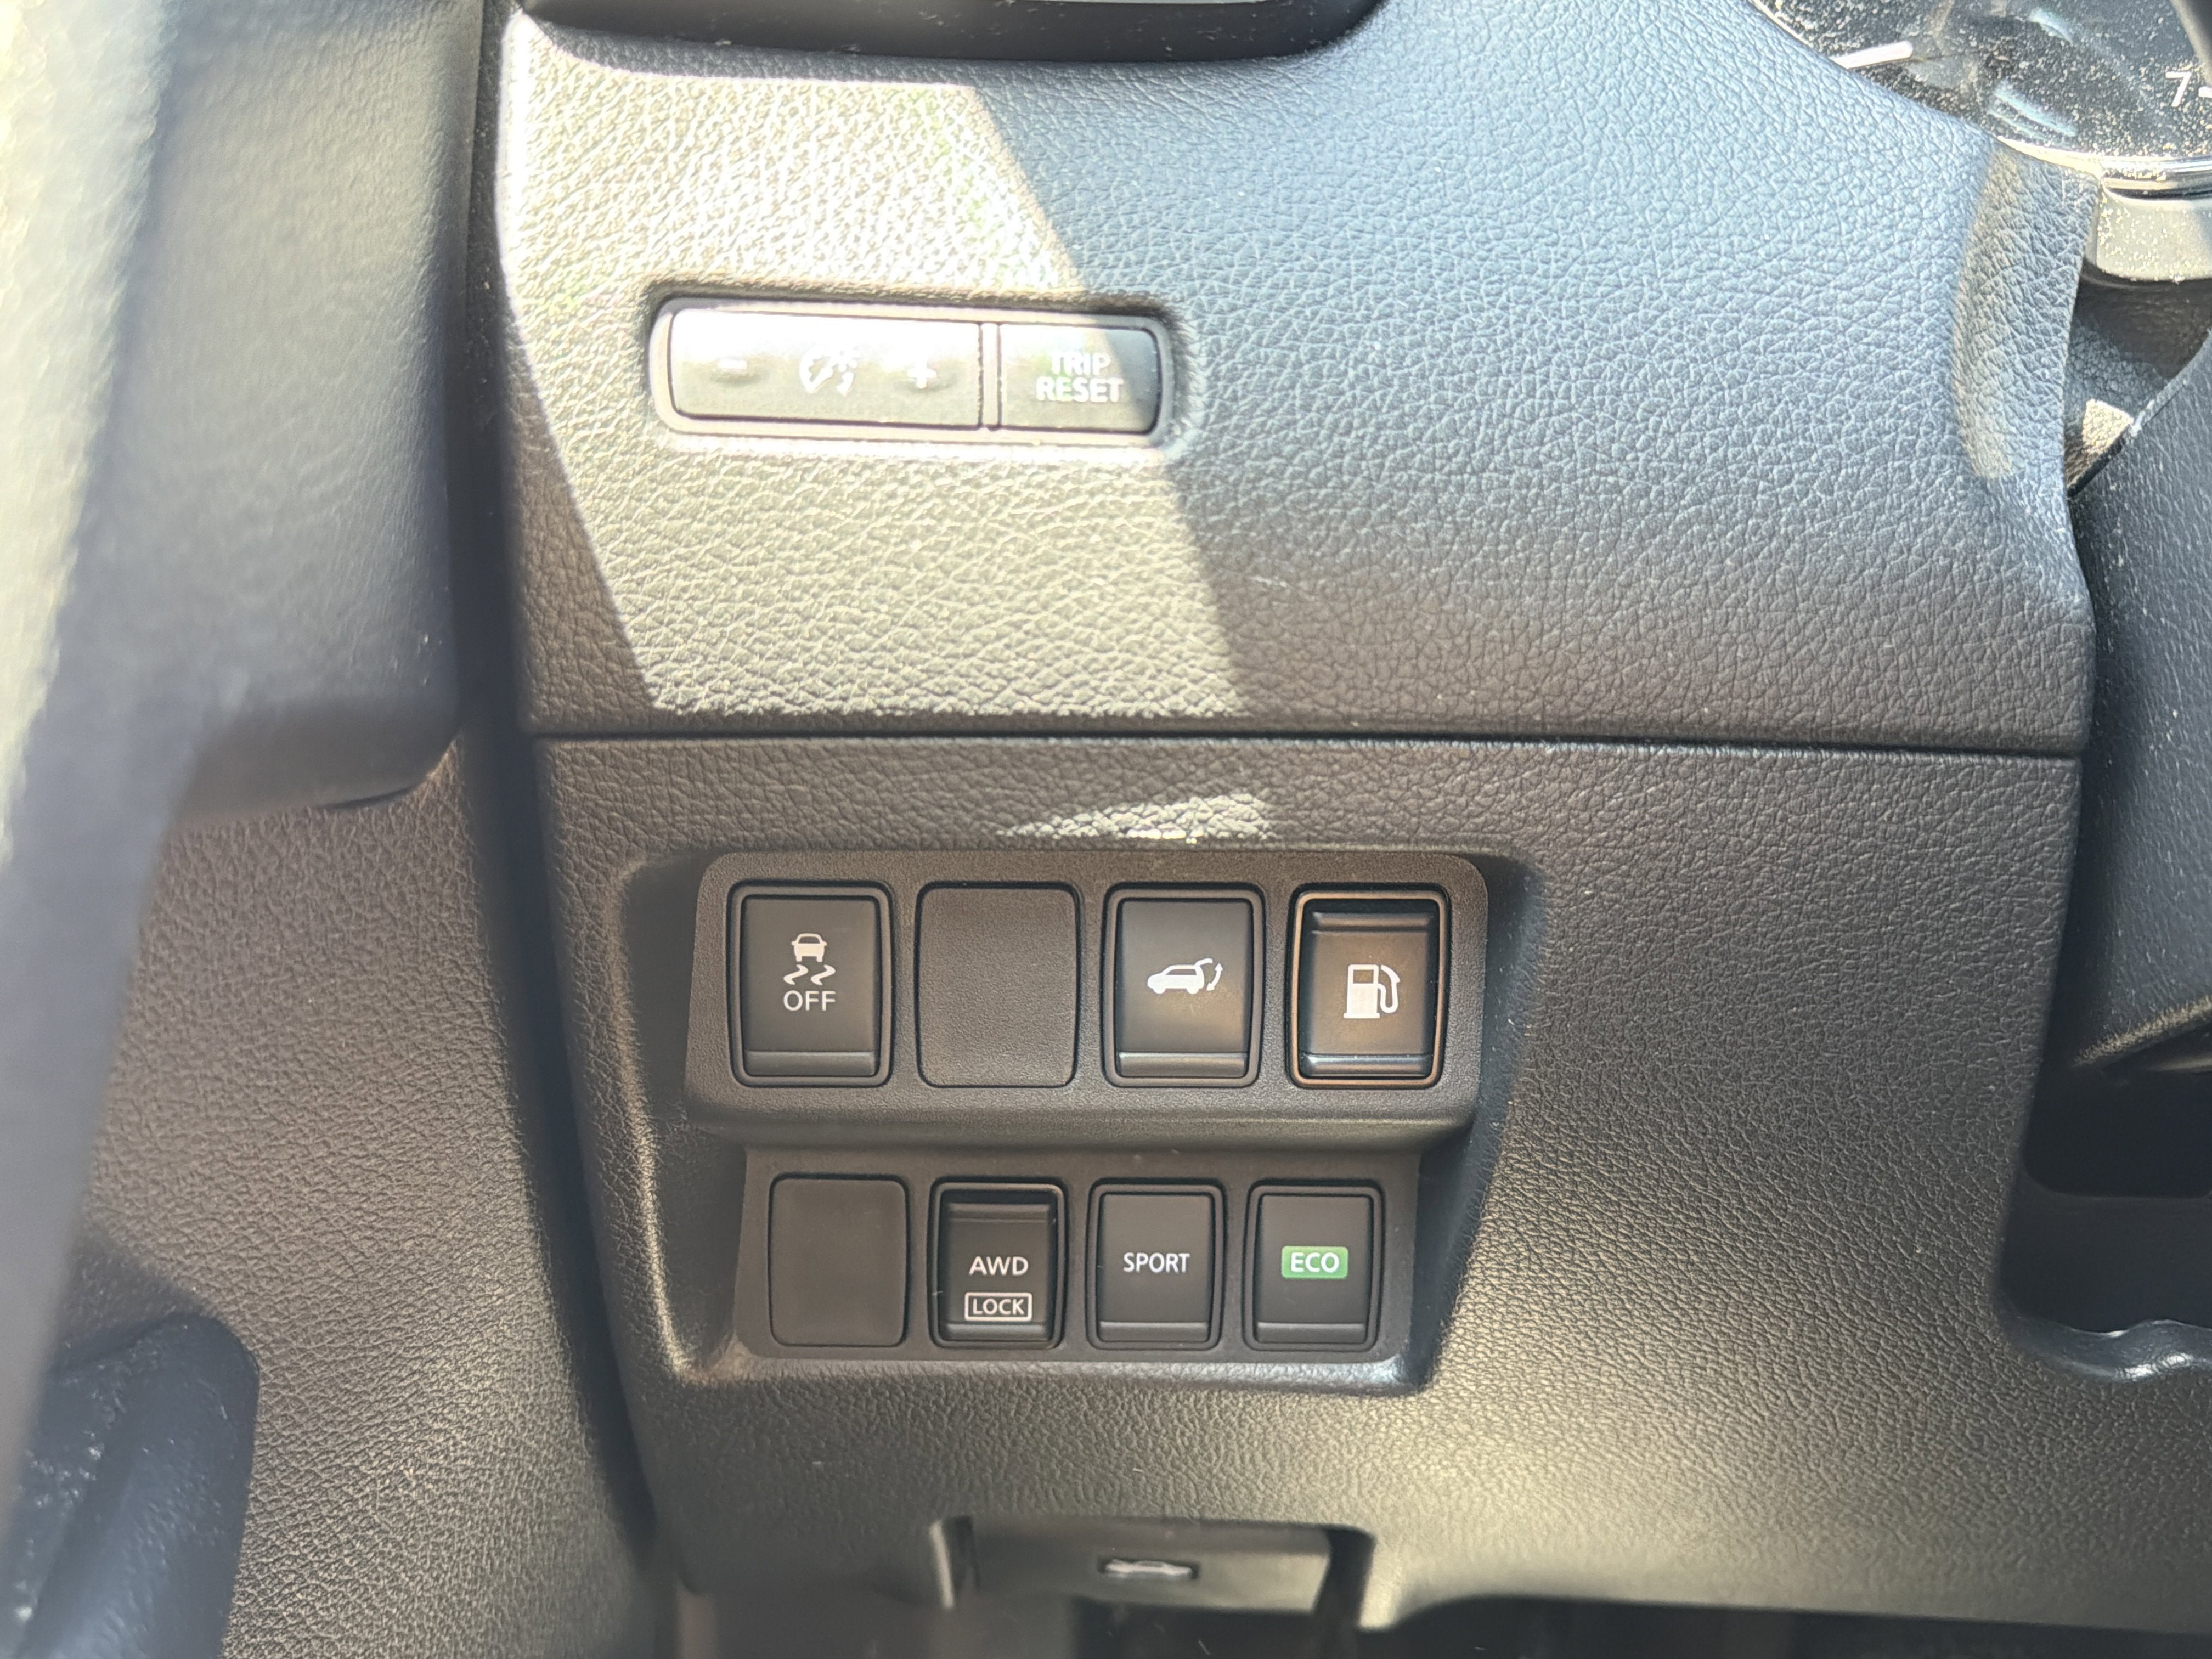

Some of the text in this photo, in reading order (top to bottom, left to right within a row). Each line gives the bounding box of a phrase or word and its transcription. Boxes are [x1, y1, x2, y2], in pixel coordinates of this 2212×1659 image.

[2165, 71, 2192, 107] 7
[1049, 352, 1111, 375] TRIP
[1036, 377, 1124, 403] RESET
[783, 990, 836, 1011] OFF
[968, 1255, 1029, 1276] AWD
[1123, 1251, 1190, 1273] SPORT
[1290, 1252, 1339, 1274] ECO
[972, 1297, 1025, 1316] LOCK
